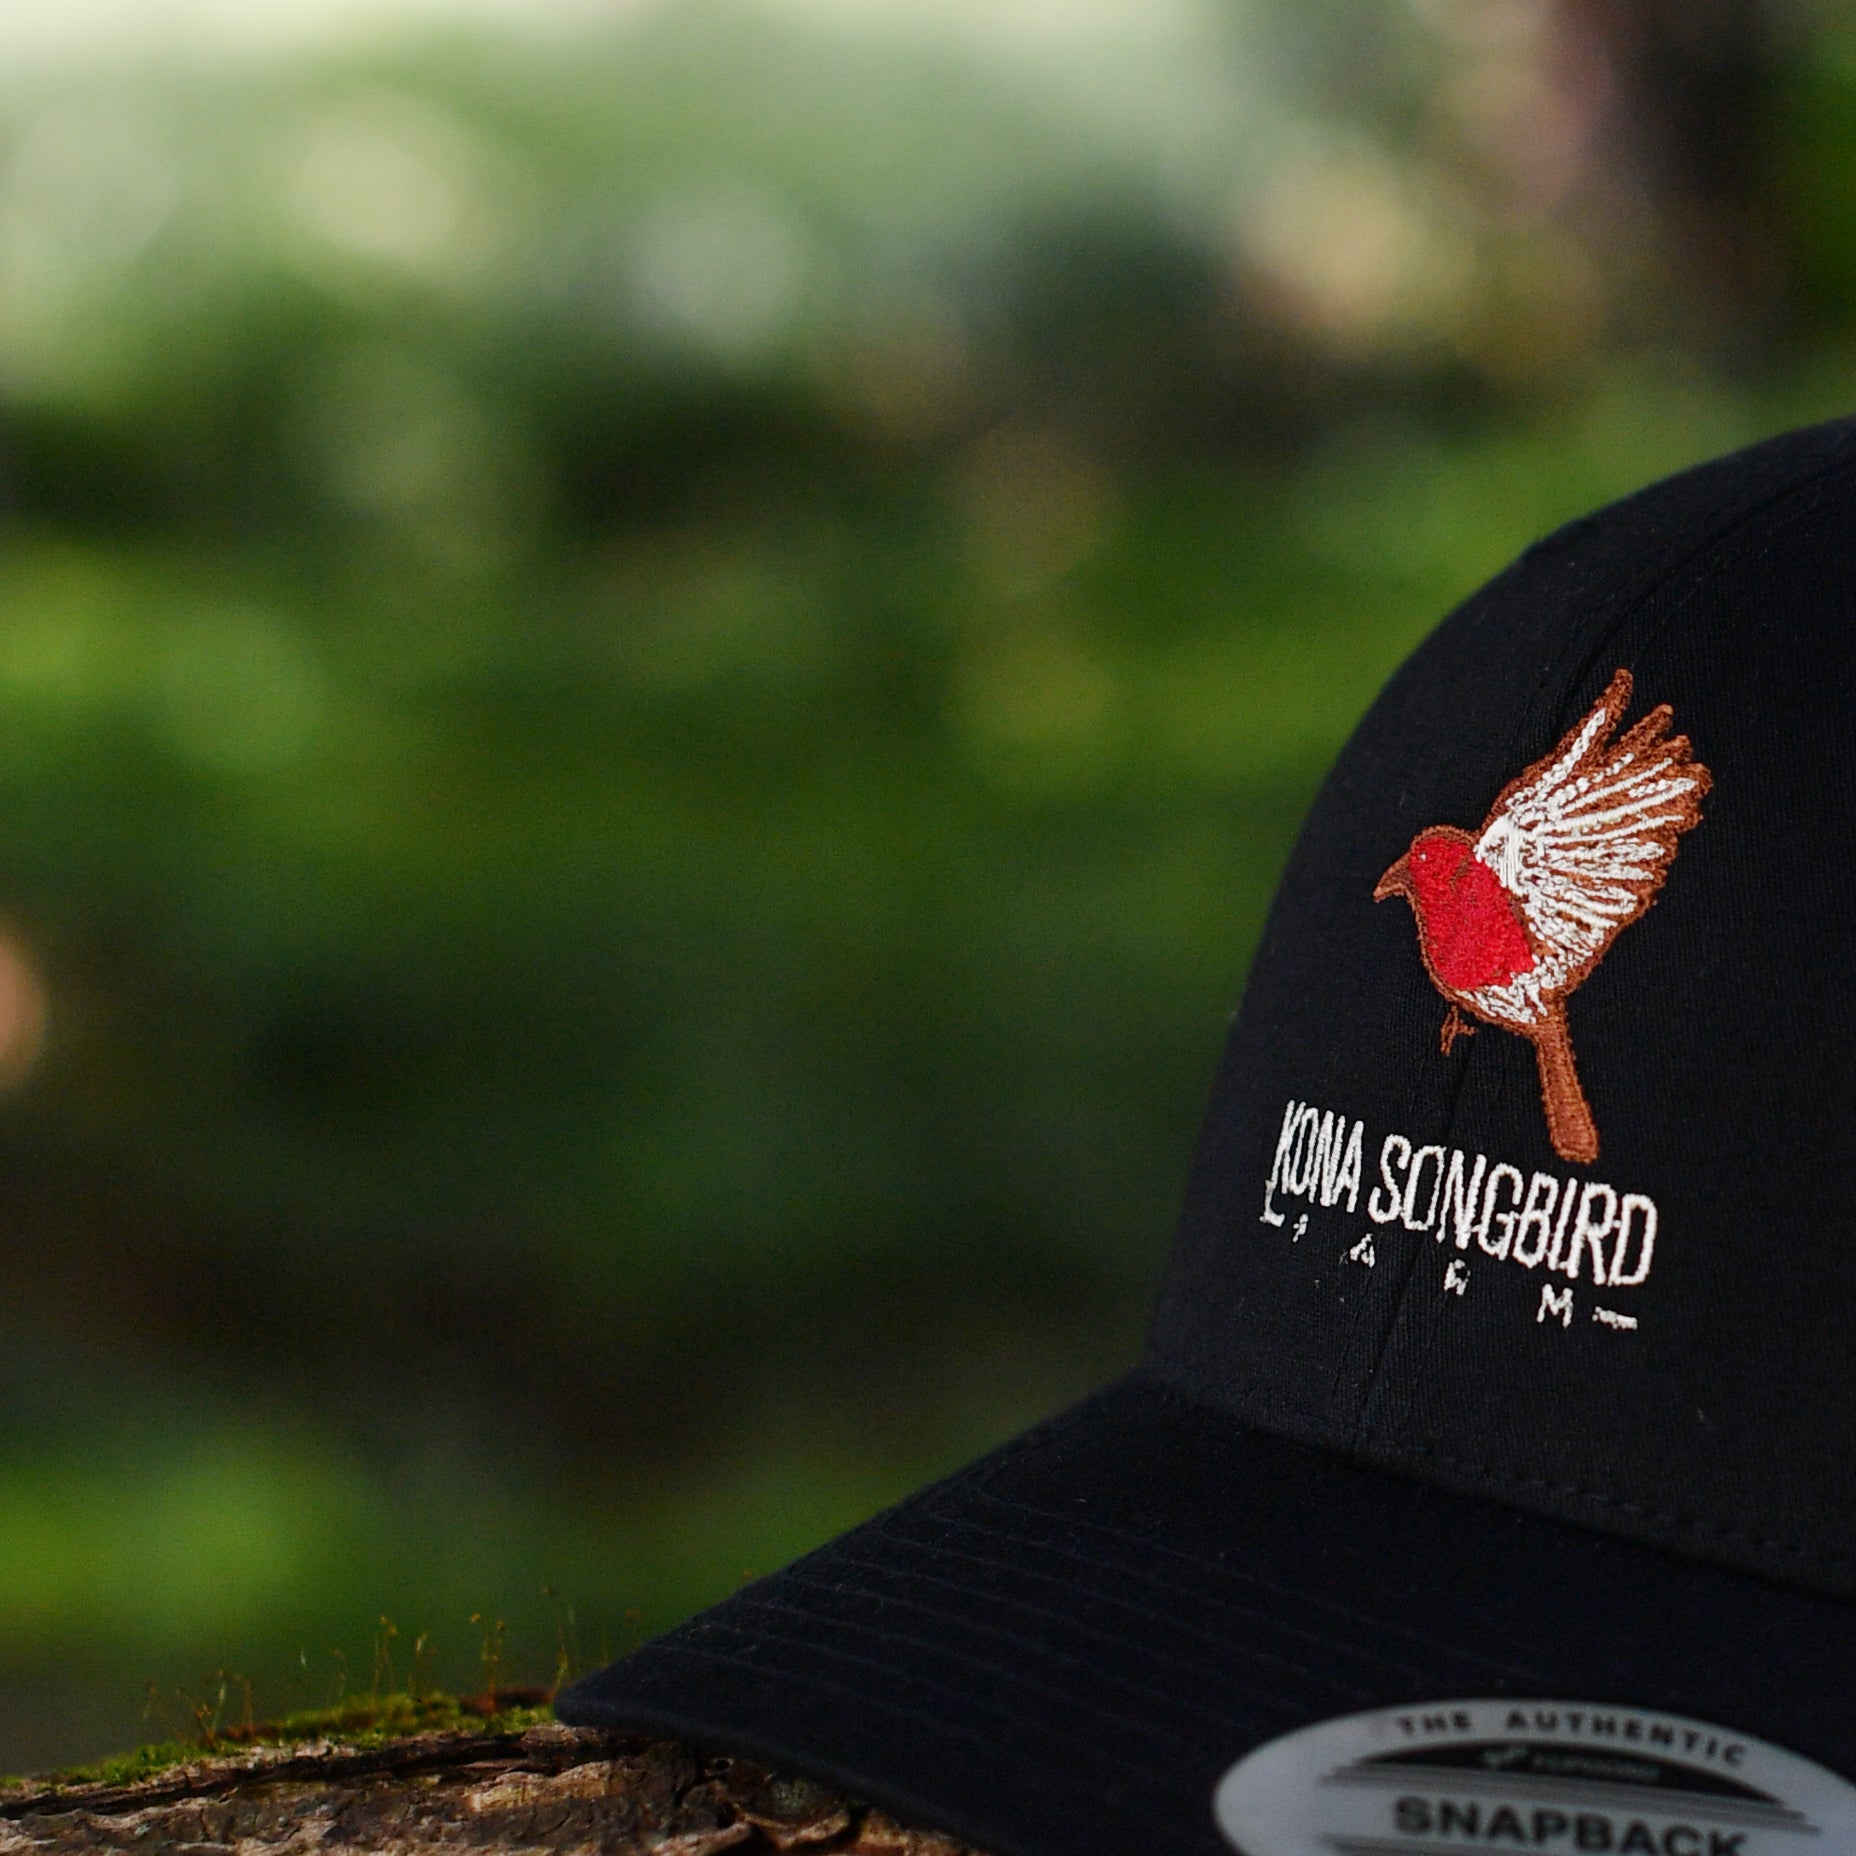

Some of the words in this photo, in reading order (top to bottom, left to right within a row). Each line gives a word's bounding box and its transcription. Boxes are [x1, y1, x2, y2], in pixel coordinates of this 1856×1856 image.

[1268, 1100, 1365, 1213] KONA
[1367, 1134, 1658, 1287] SONGBIRD
[1397, 1710, 1473, 1736] THE
[1505, 1709, 1747, 1768] AUTHENTIC
